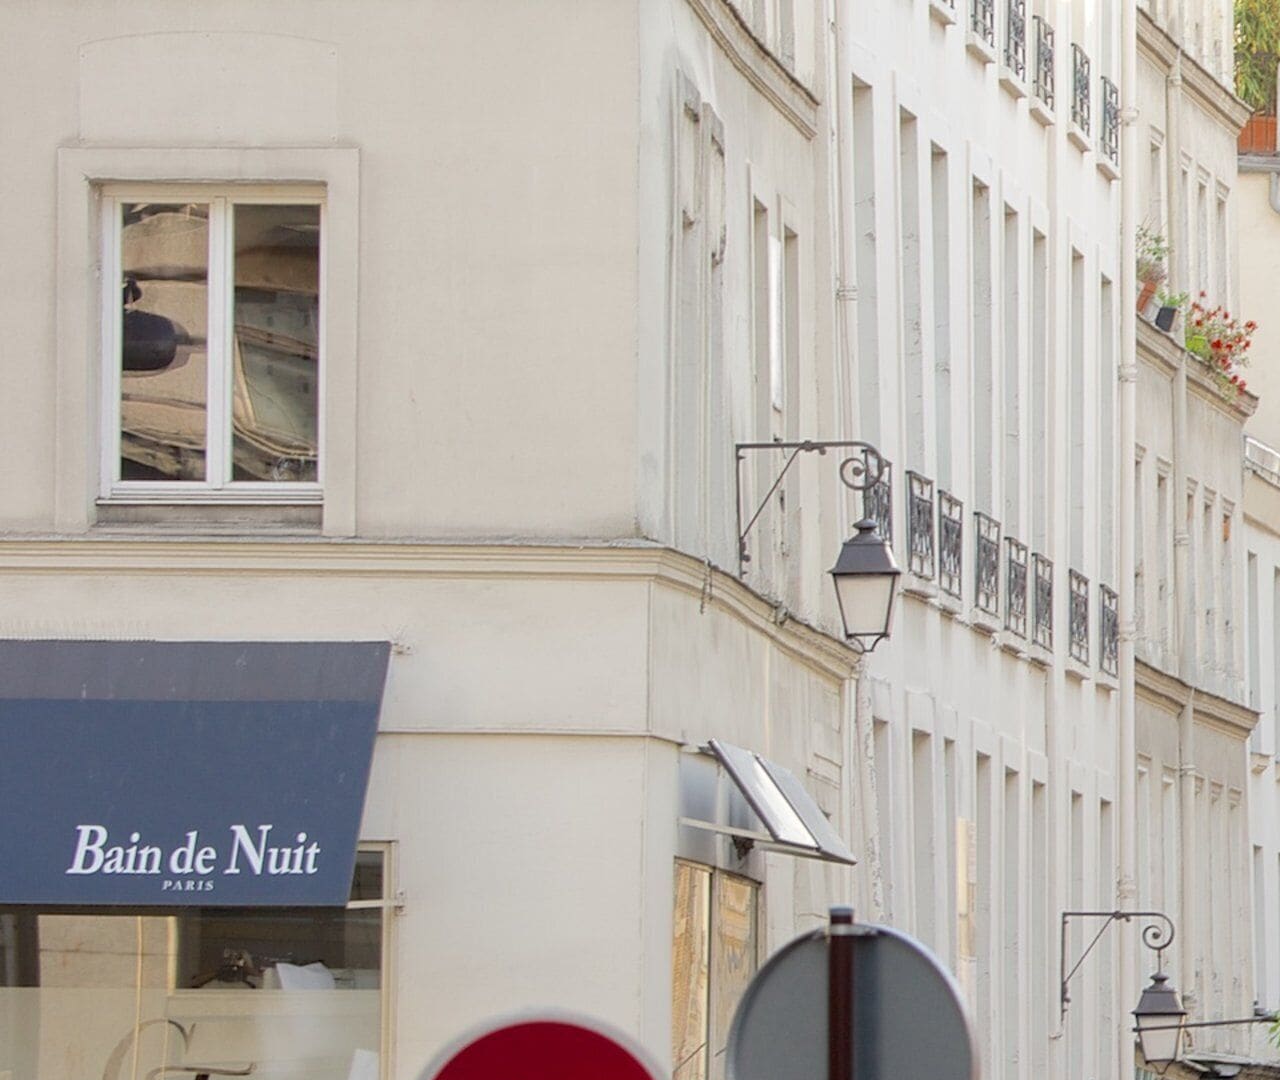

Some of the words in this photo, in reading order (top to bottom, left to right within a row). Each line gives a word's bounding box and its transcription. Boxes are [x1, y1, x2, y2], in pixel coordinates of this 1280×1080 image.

[66, 824, 161, 874] Bain
[169, 831, 217, 874] de
[223, 824, 320, 875] Nuit
[161, 880, 214, 891] PARIS
